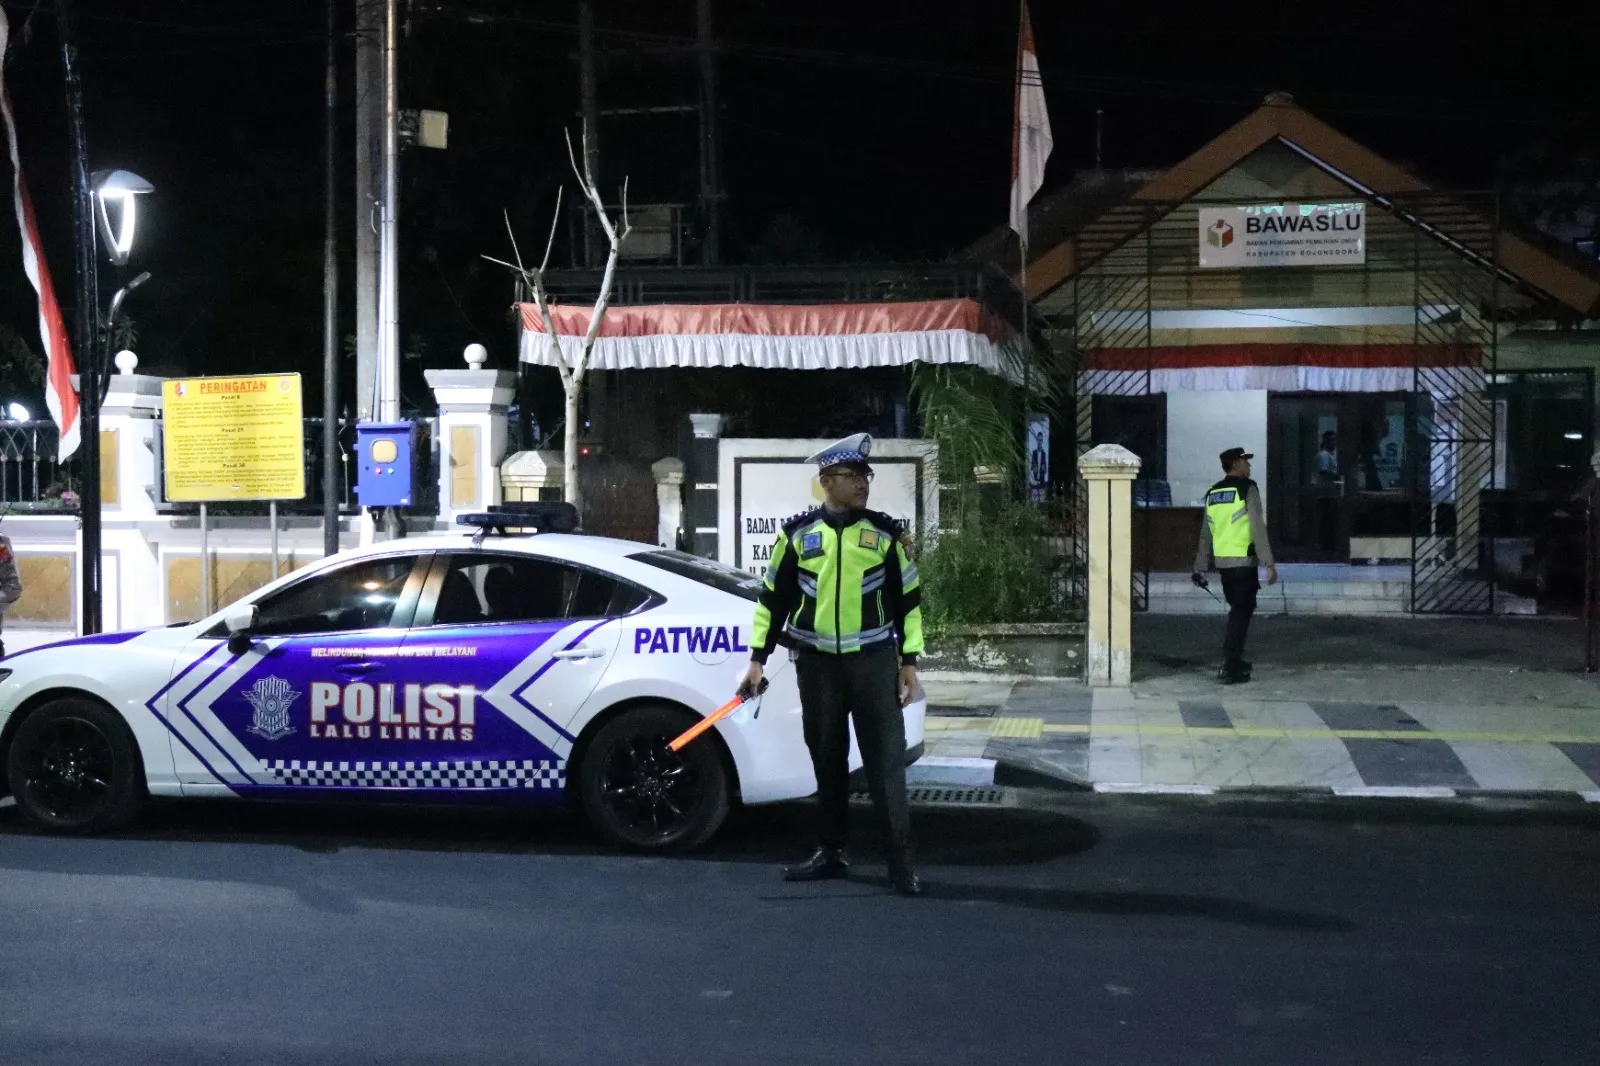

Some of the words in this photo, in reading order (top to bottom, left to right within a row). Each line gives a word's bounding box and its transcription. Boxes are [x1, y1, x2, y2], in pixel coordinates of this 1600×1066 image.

[1246, 214, 1361, 233] BAWASLU
[199, 381, 267, 393] PERINGATAN
[746, 518, 776, 533] BADAN
[634, 626, 748, 653] PATWAL
[435, 646, 477, 656] MELAYANI
[311, 682, 475, 725] POLISI
[310, 724, 371, 738] LALU
[380, 726, 473, 741] LINTAS
